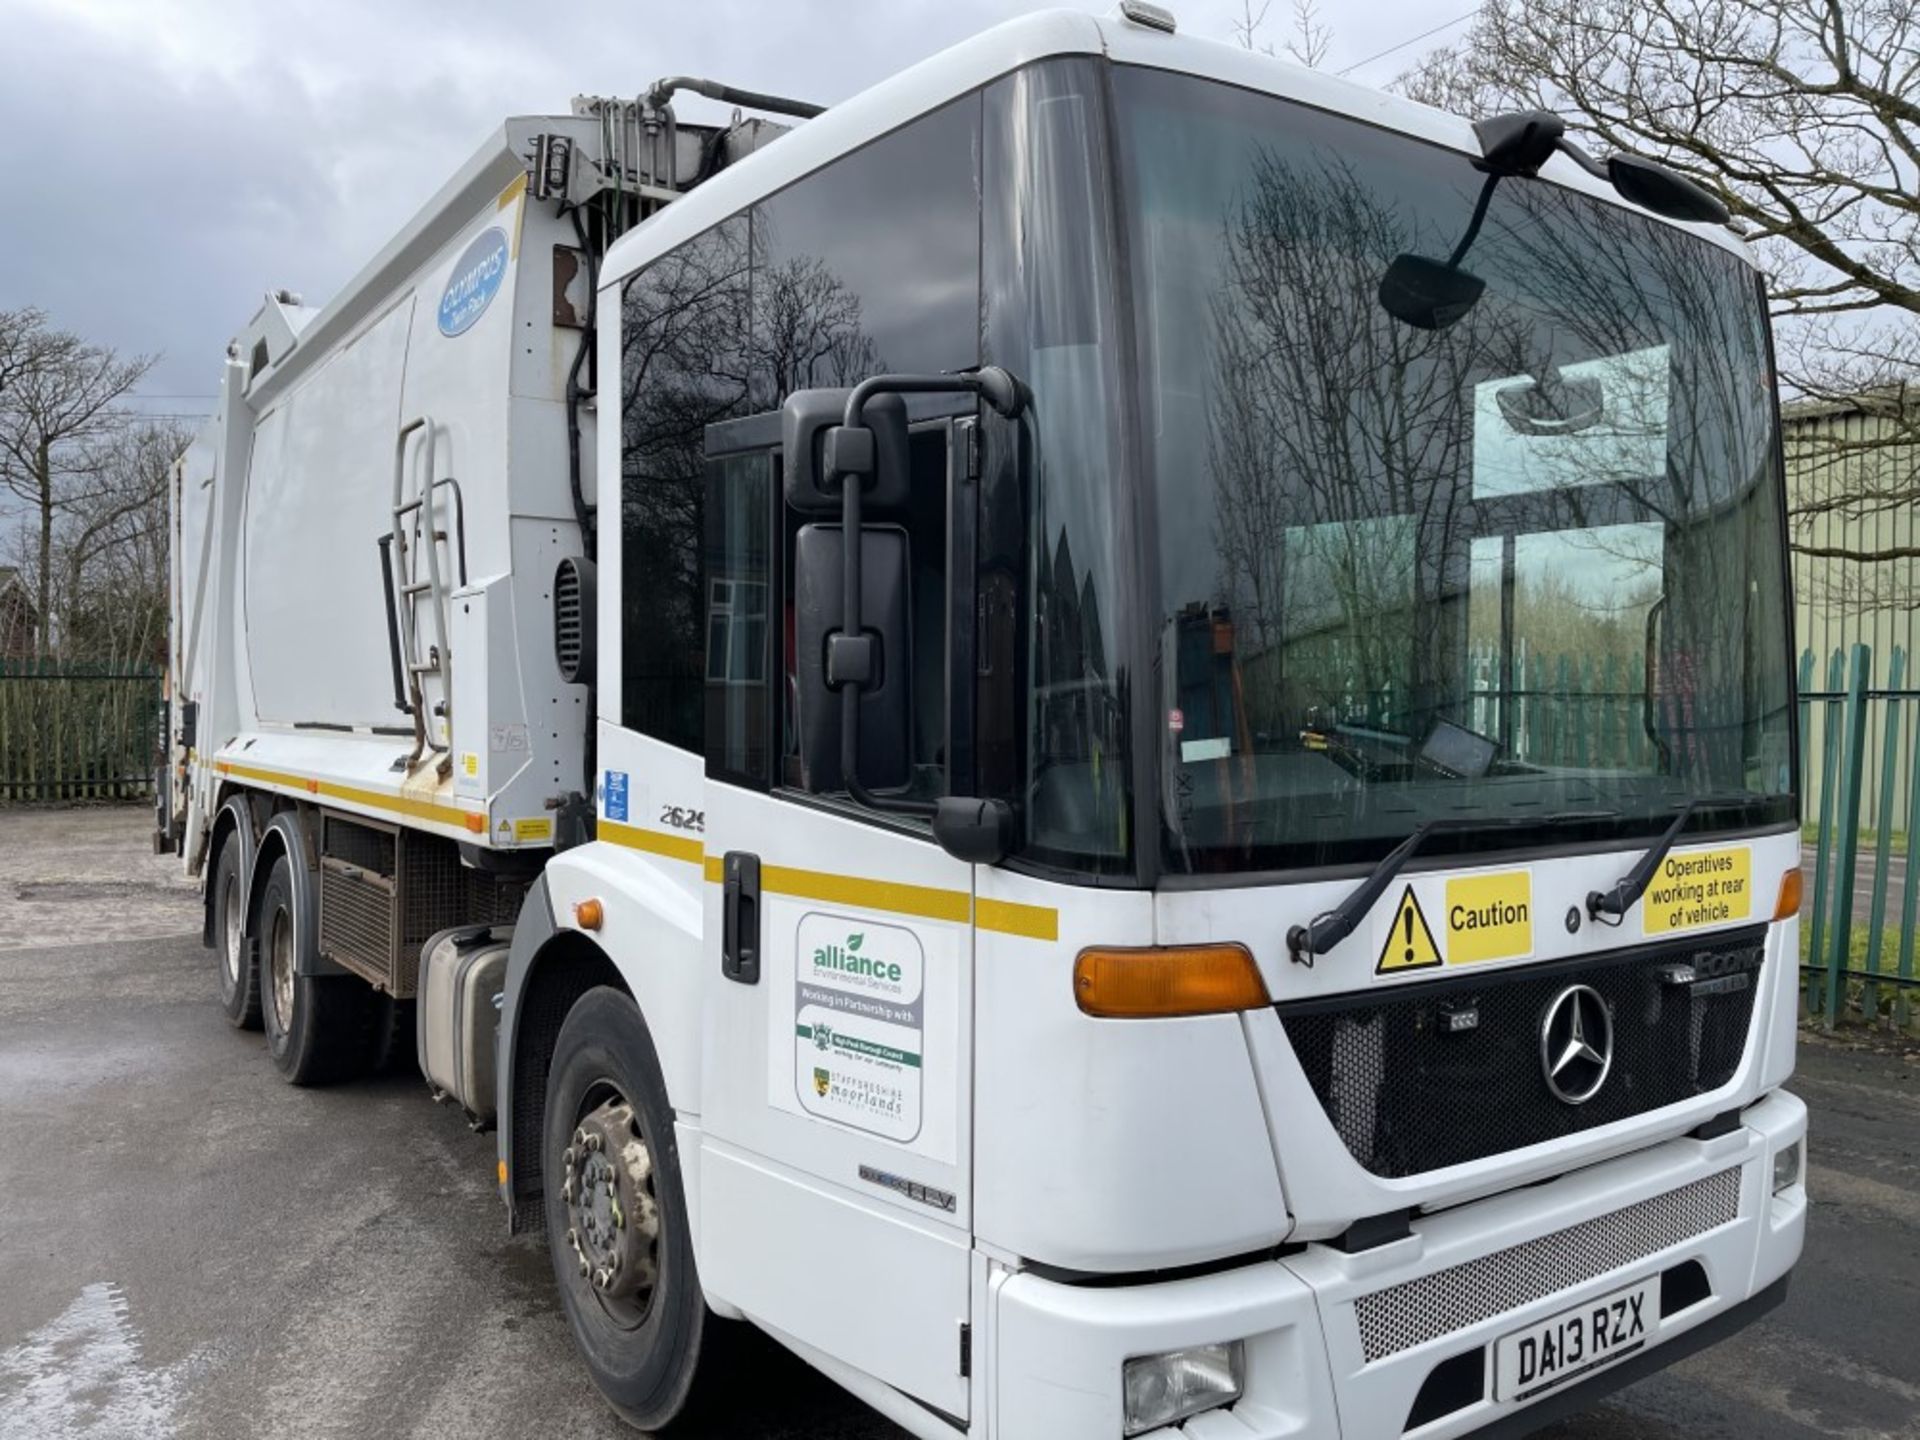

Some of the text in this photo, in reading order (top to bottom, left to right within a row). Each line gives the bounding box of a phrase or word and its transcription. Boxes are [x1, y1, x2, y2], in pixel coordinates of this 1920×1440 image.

[443, 246, 504, 313] OLYMPUS
[1666, 855, 1733, 880] Operatives
[1651, 879, 1744, 904] working at rear
[1450, 900, 1528, 931] Caution
[1670, 901, 1729, 927] of vehicle
[814, 945, 902, 982] alliance
[868, 977, 902, 995] Services
[802, 988, 915, 1022] Working in Partnership with
[831, 1085, 902, 1114] moorlands
[1519, 1291, 1644, 1386] DA13 RZX
